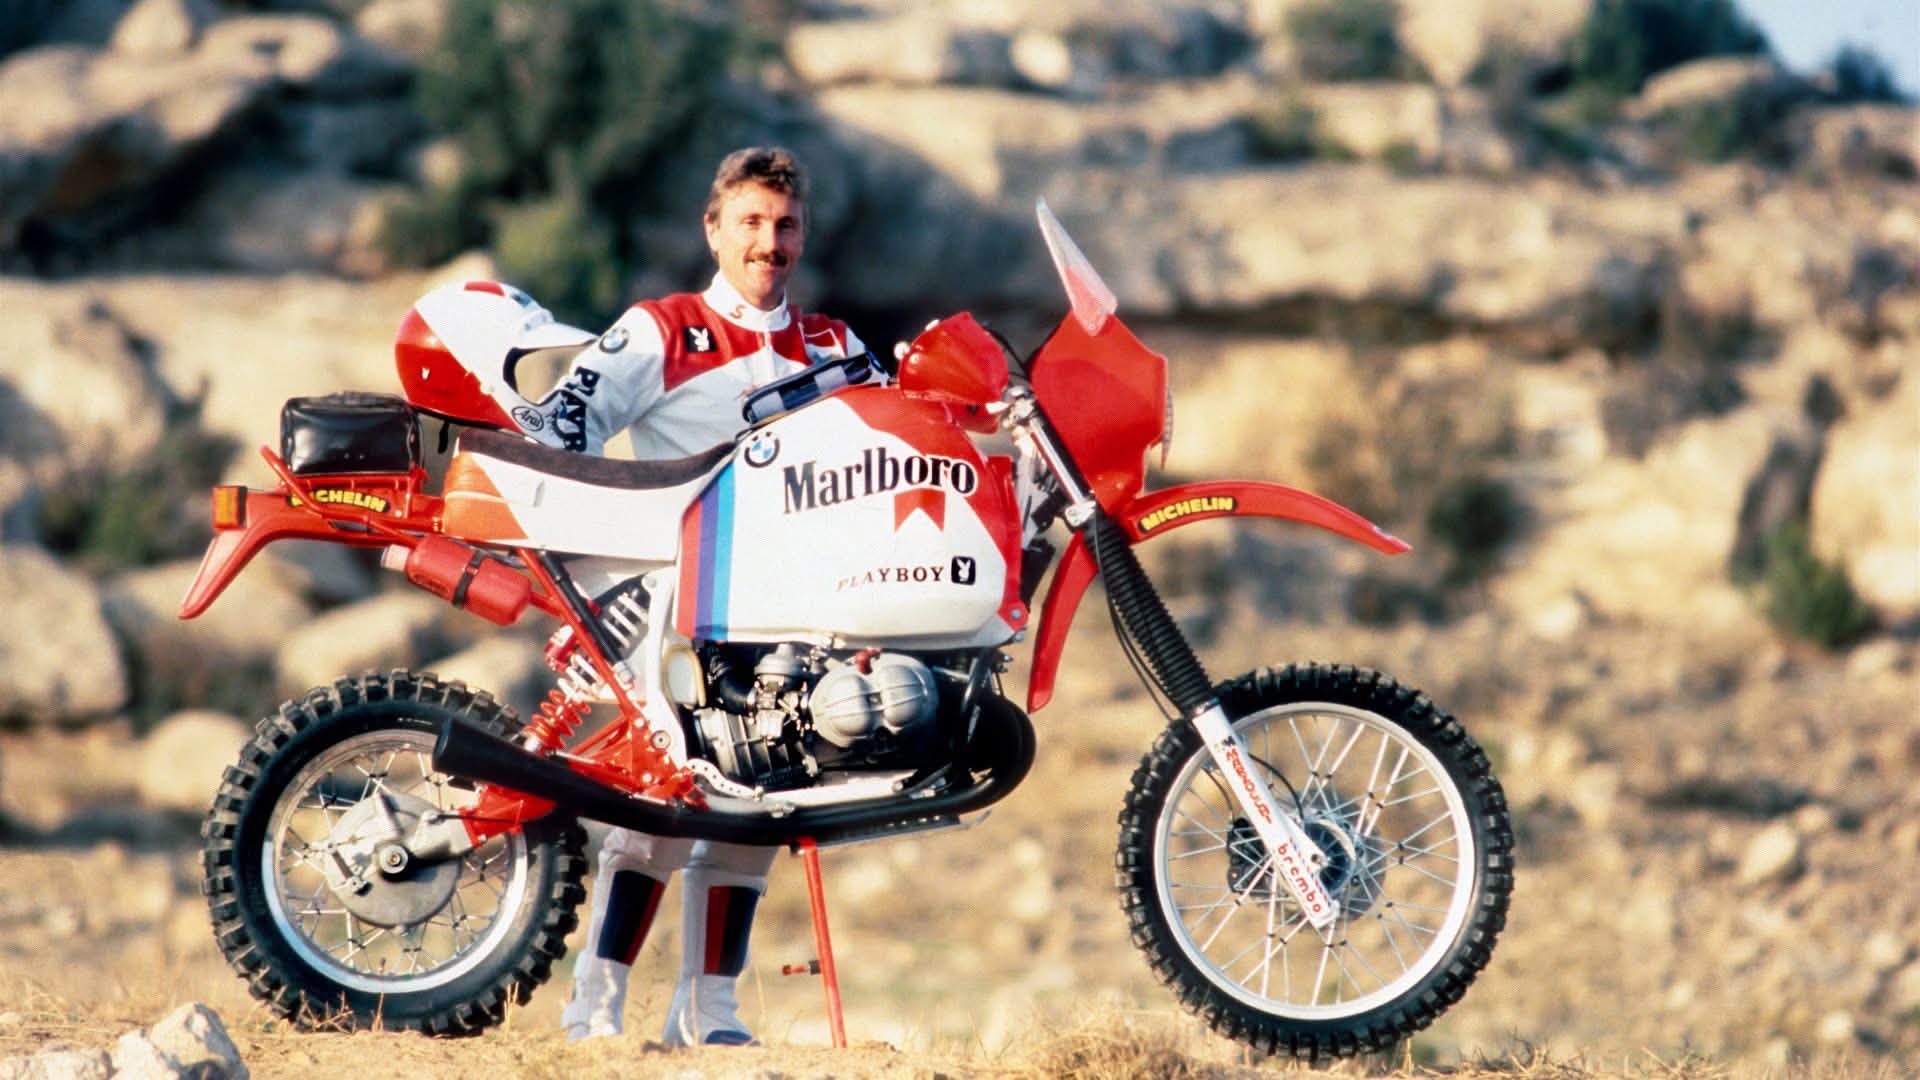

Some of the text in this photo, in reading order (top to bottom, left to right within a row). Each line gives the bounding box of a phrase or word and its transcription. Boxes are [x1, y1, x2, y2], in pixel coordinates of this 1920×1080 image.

[783, 447, 976, 514] Marlboro
[291, 490, 386, 512] CHELIN
[1140, 497, 1233, 531] MICHELIN
[836, 566, 944, 592] PLAYBOY
[1278, 843, 1321, 912] brembo
